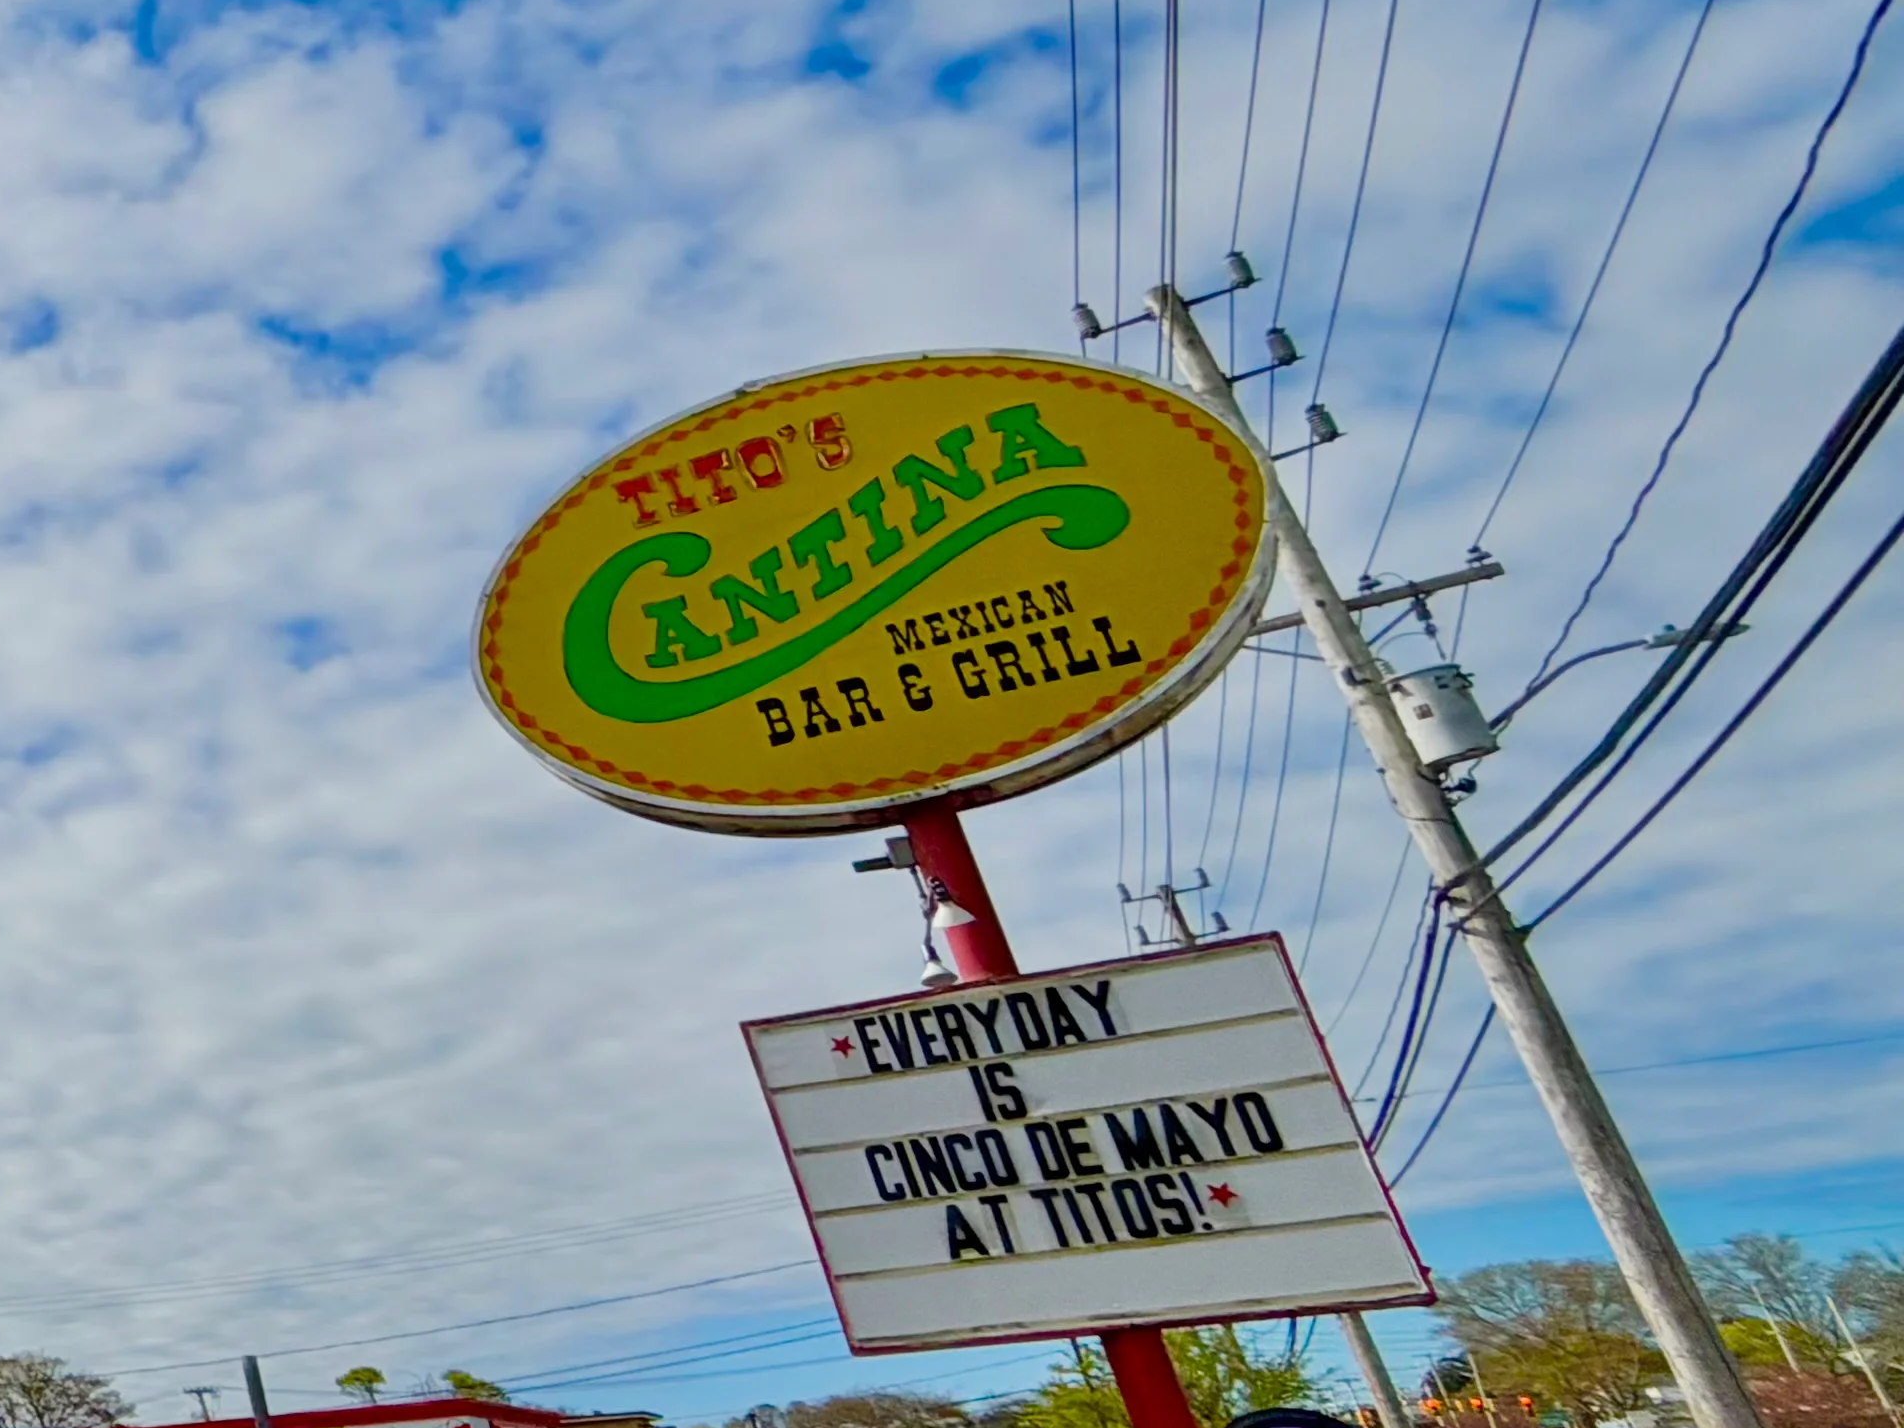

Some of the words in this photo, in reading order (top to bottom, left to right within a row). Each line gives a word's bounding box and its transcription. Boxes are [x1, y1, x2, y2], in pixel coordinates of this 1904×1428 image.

[613, 412, 853, 529] TITO'S
[562, 402, 1132, 724] CANTINA
[885, 579, 1077, 657] MEXICAN
[756, 675, 886, 748] BAR
[900, 663, 934, 712] &
[955, 617, 1143, 701] GRILL
[853, 979, 1121, 1074] EVERYDAY
[967, 1062, 1029, 1122] IS
[864, 1128, 1020, 1202] CINCO
[1024, 1117, 1105, 1181] DE
[1103, 1091, 1284, 1171] MAYO
[944, 1198, 1017, 1261] AT
[1030, 1170, 1214, 1249] TITOS!
